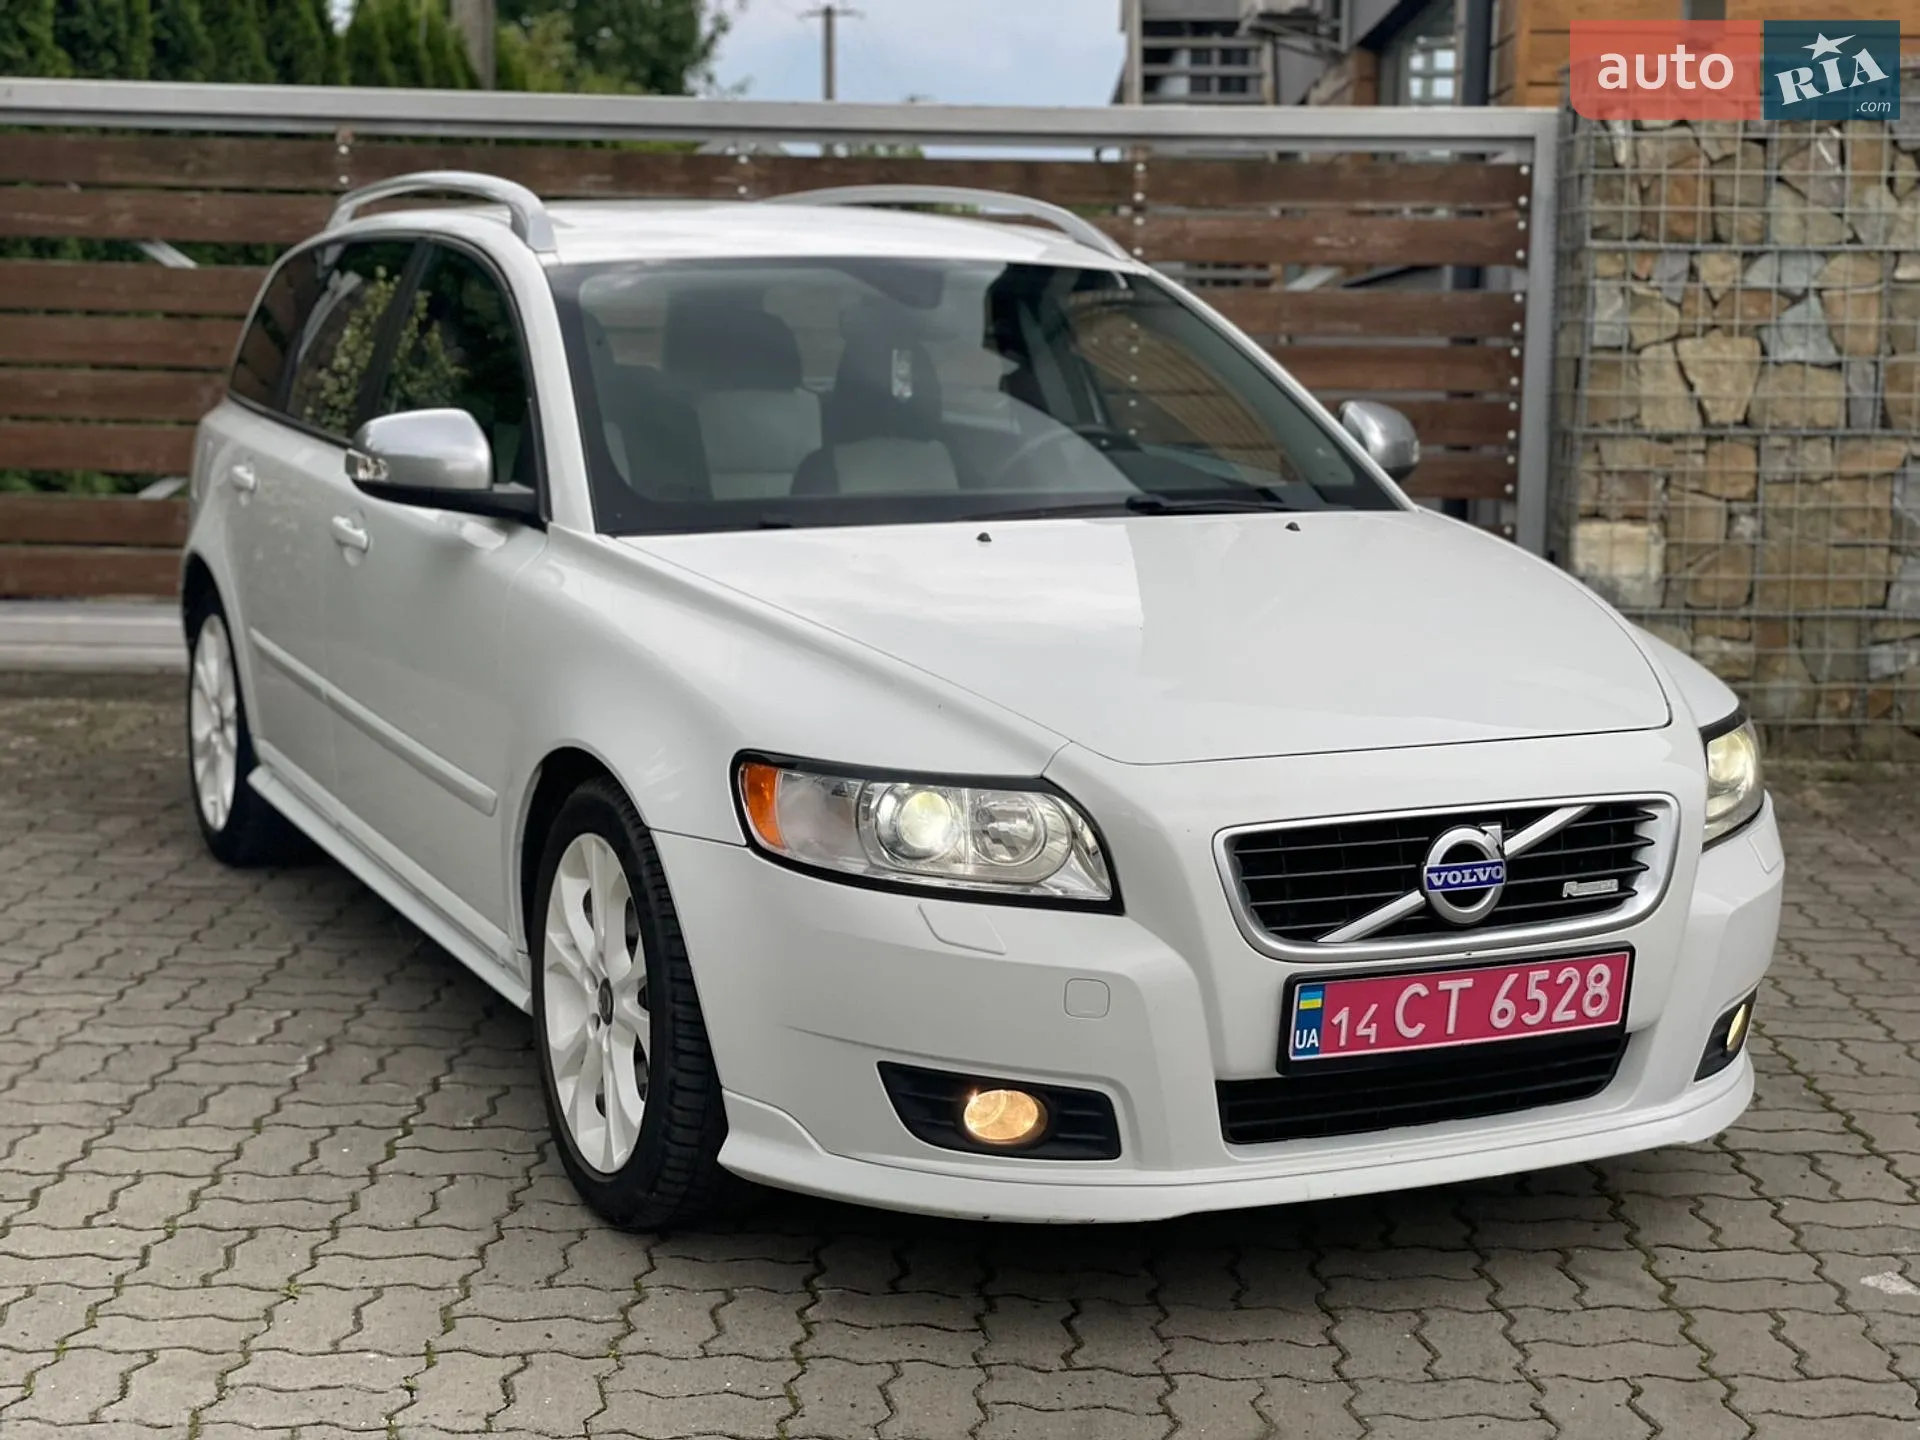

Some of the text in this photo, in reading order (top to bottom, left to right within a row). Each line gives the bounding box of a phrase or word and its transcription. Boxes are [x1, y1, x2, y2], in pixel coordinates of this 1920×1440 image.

[1427, 865, 1504, 887] VOLVO
[1331, 963, 1611, 1047] 14 CT 6528
[1294, 1028, 1319, 1049] UA
